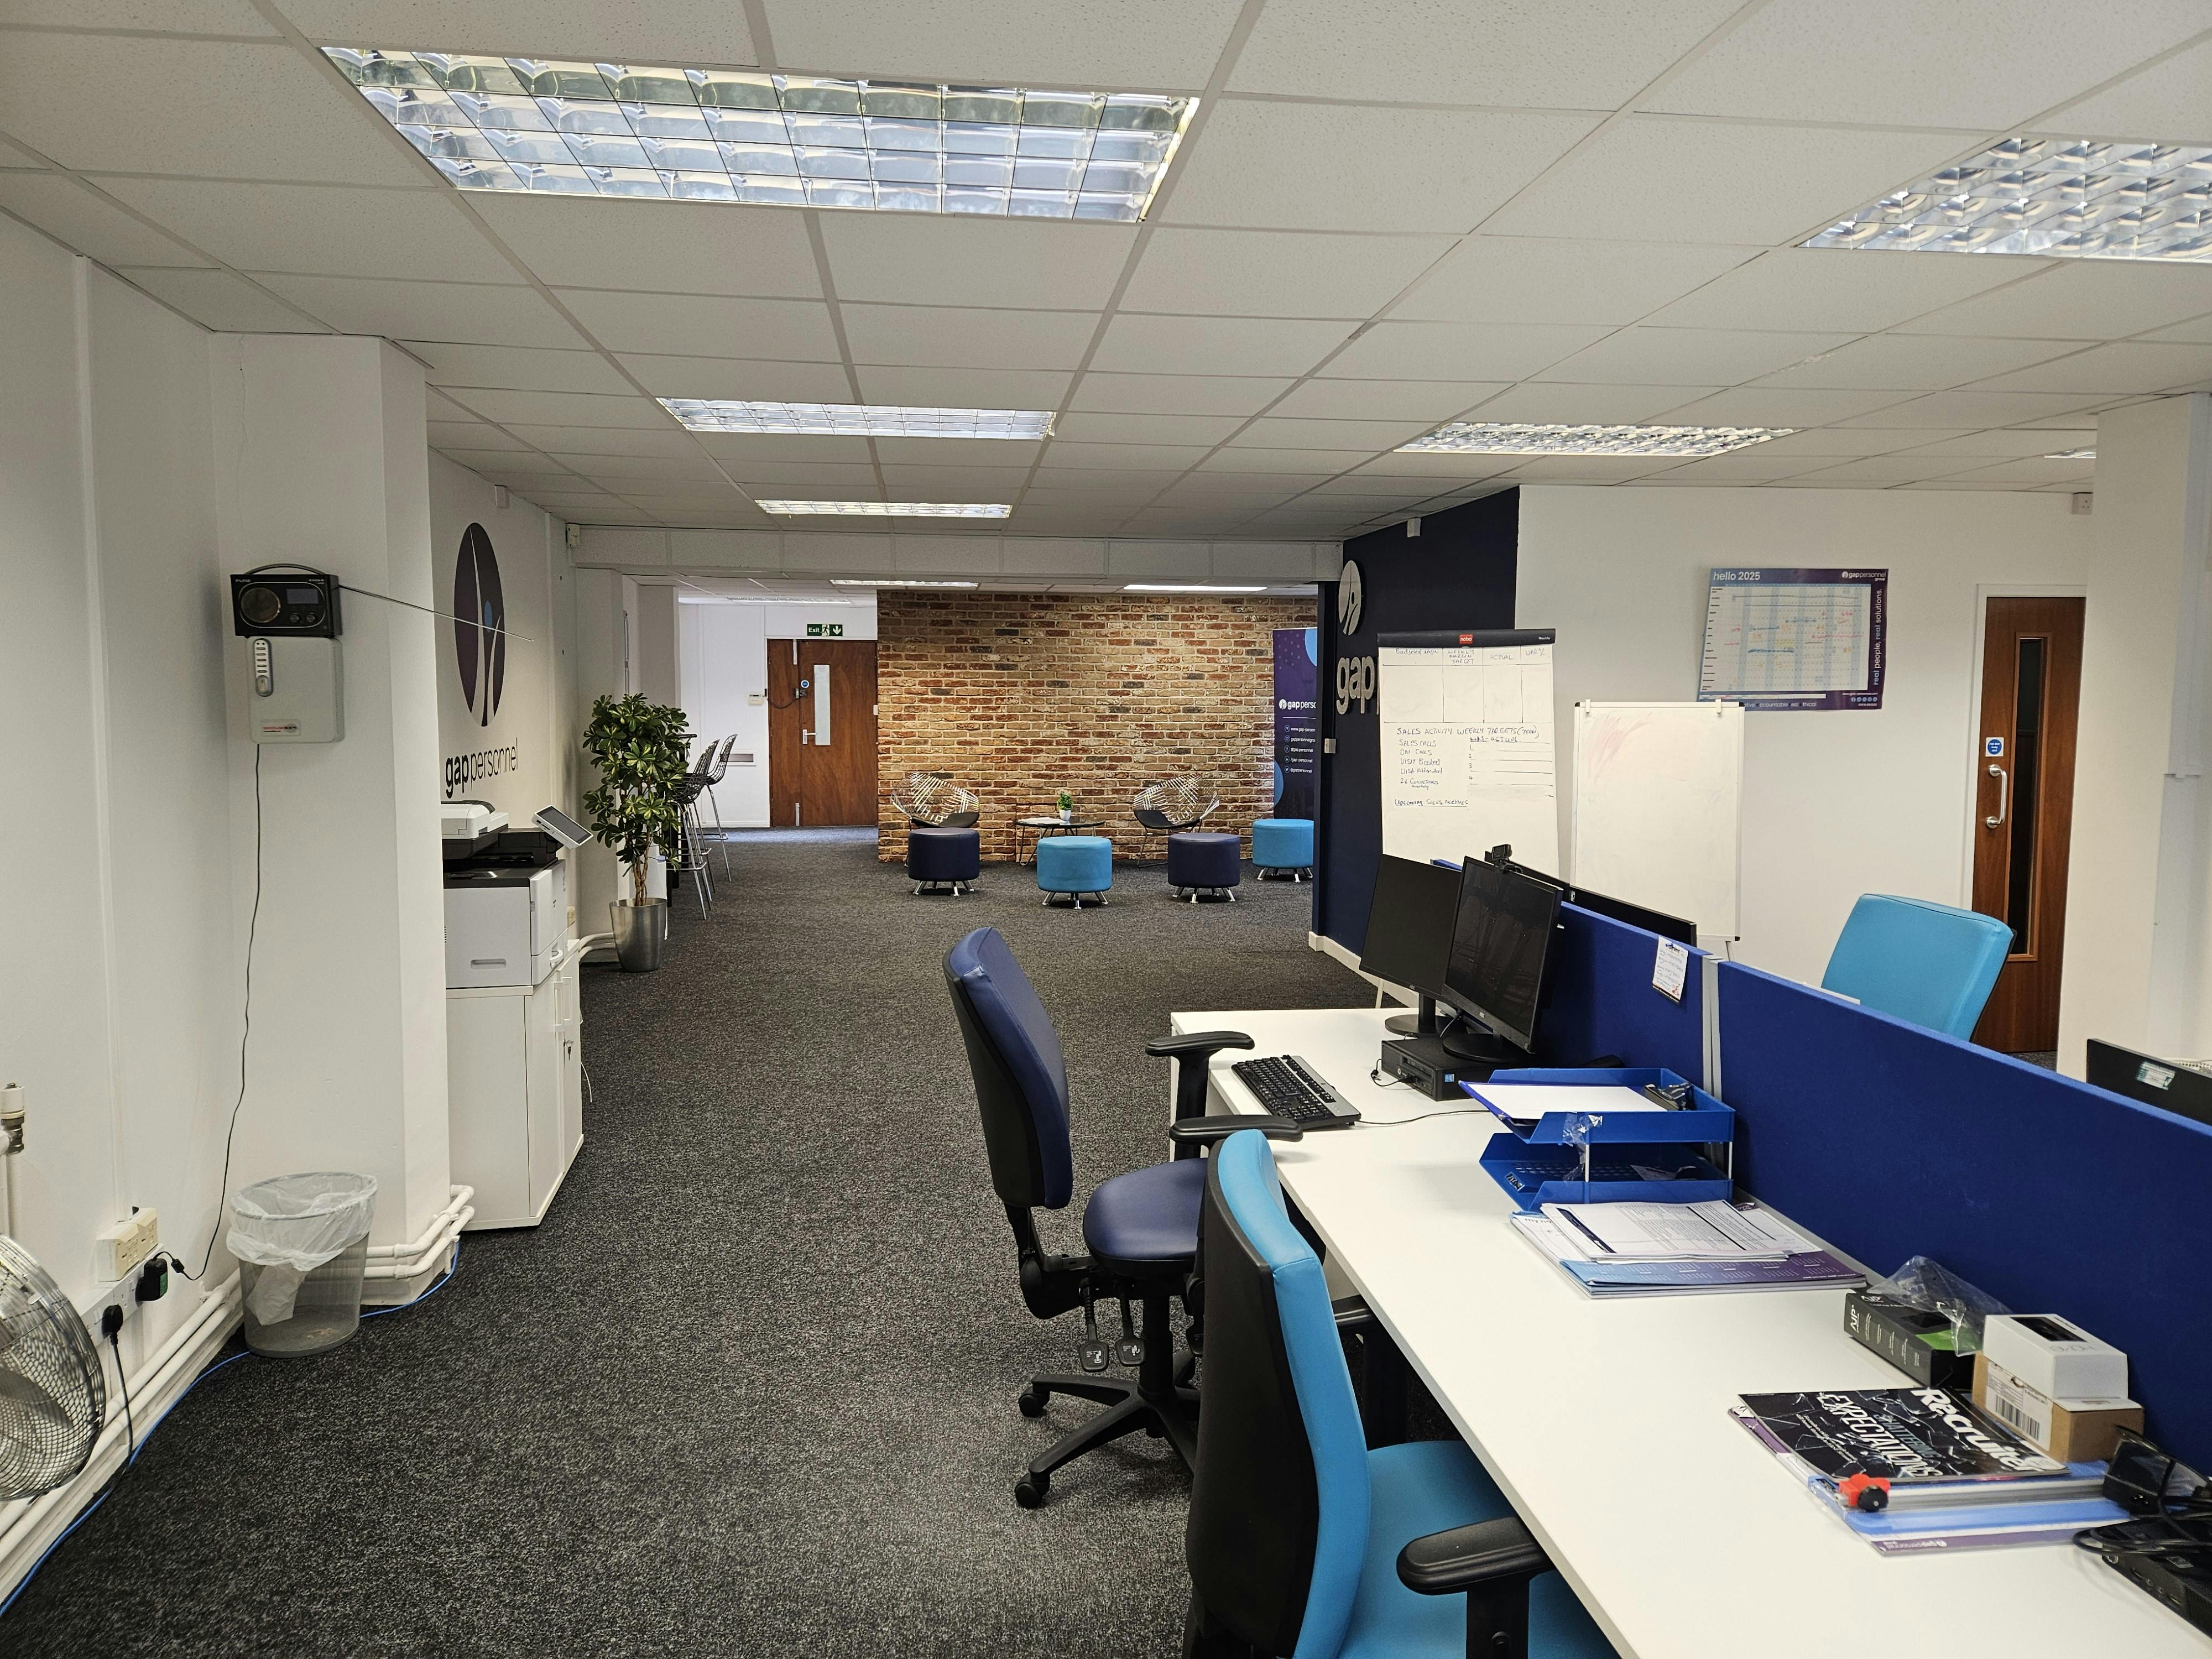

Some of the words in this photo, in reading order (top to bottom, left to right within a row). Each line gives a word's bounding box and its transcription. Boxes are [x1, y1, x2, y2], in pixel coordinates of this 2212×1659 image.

[1713, 571, 1736, 581] hello
[1738, 572, 1761, 581] 2025
[1818, 1393, 1944, 1478] EXPECTATIONS
[1910, 1386, 2044, 1472] Recruiter
